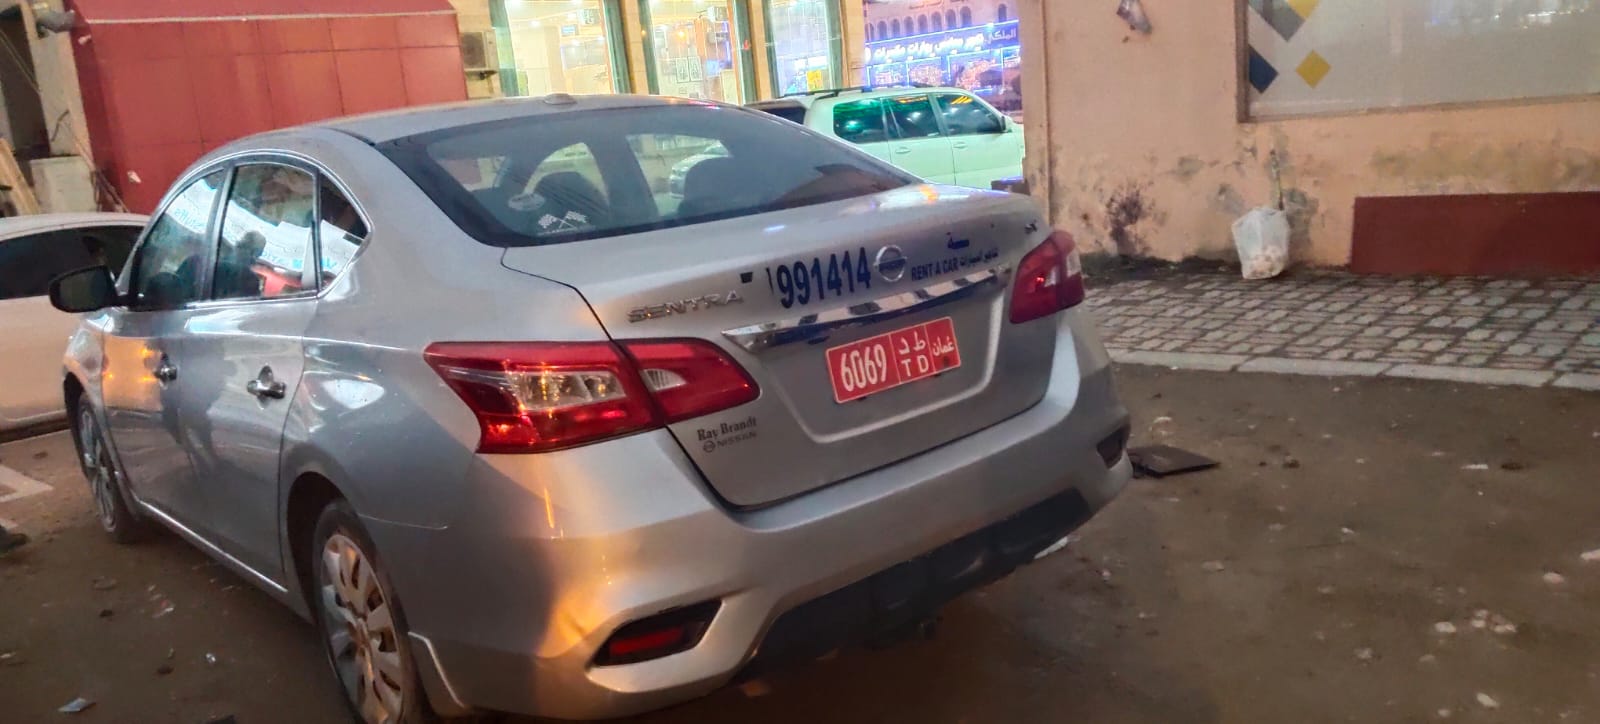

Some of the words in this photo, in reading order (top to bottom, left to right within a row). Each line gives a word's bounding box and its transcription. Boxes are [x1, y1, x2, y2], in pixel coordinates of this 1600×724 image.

[911, 263, 933, 281] RENT
[943, 257, 959, 273] CAR
[626, 289, 744, 323] SENTRA
[840, 343, 887, 392] 6069
[697, 428, 719, 442] Ray
[719, 415, 757, 435] Brandt
[717, 431, 757, 448] NISSAN
